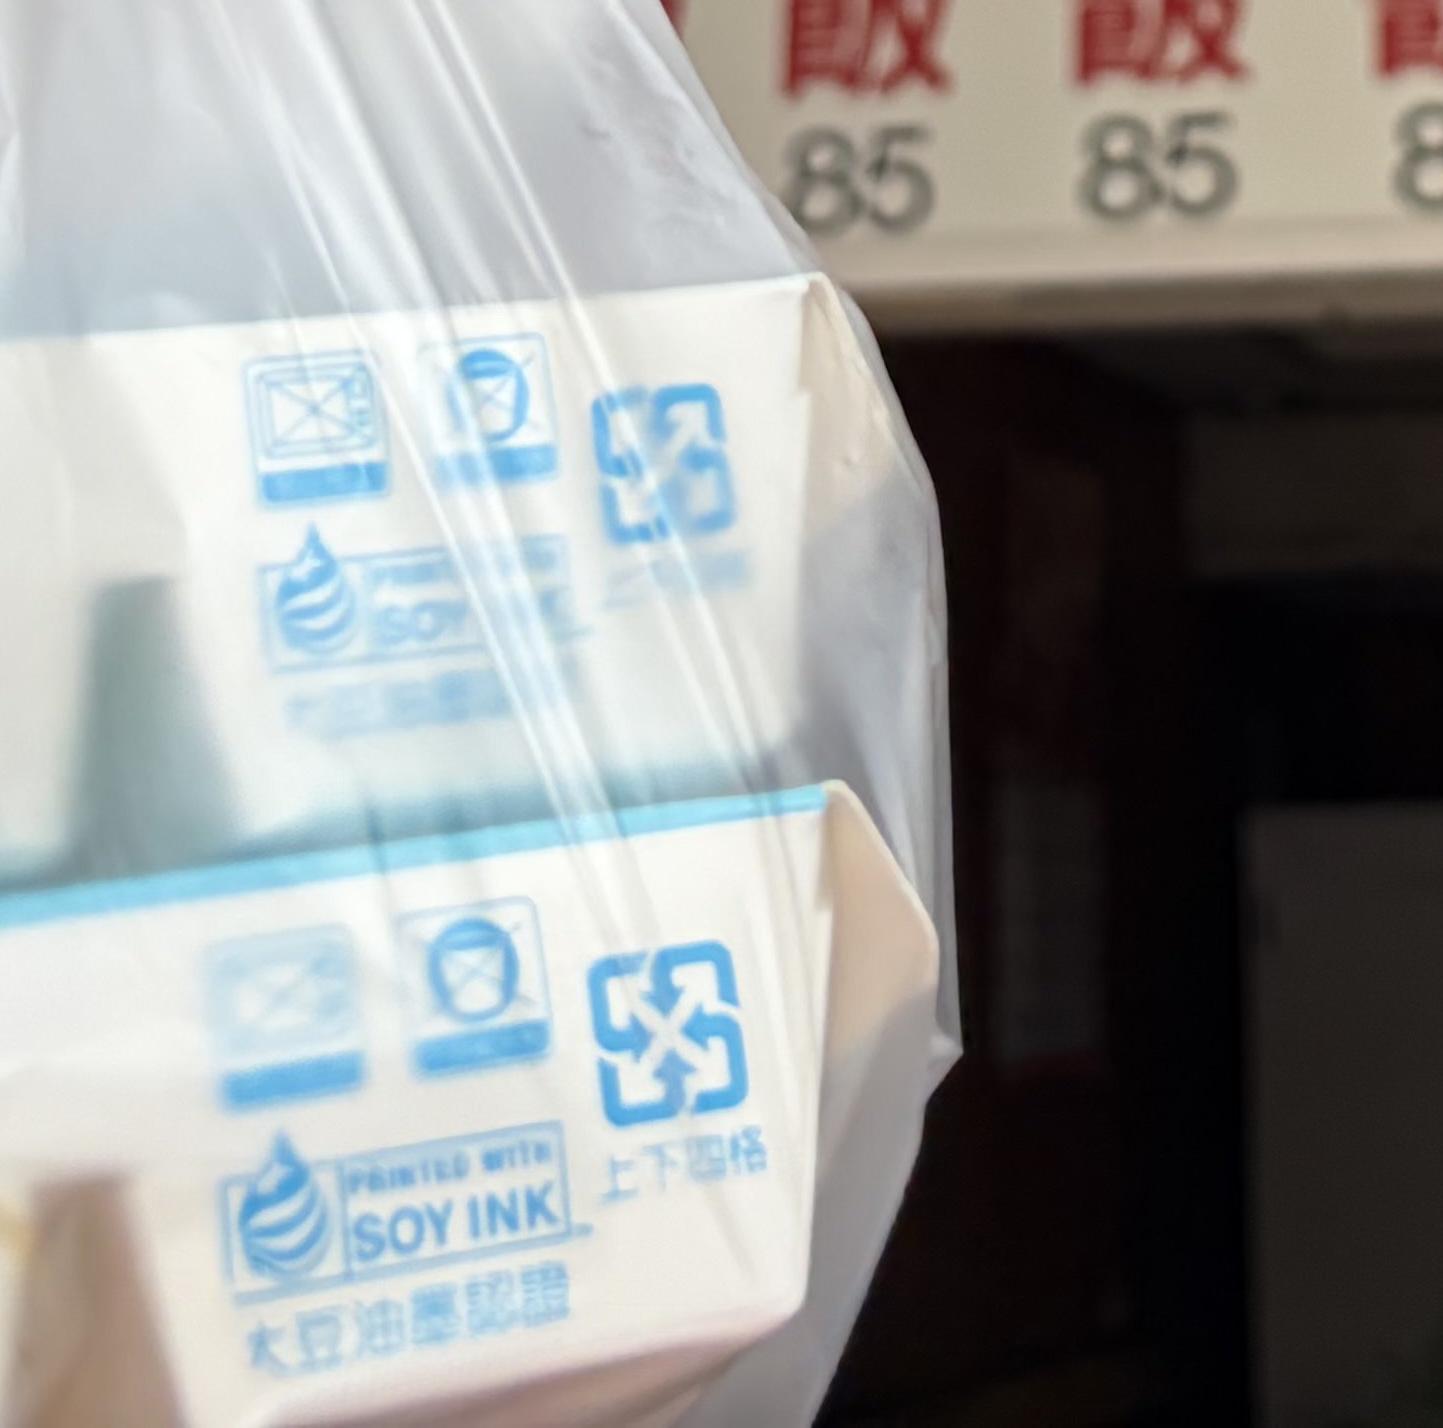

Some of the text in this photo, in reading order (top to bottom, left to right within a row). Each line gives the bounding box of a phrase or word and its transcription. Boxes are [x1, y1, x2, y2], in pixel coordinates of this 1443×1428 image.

[781, 124, 934, 236] 85
[1078, 109, 1238, 224] 85
[355, 1181, 560, 1262] SOY INK
